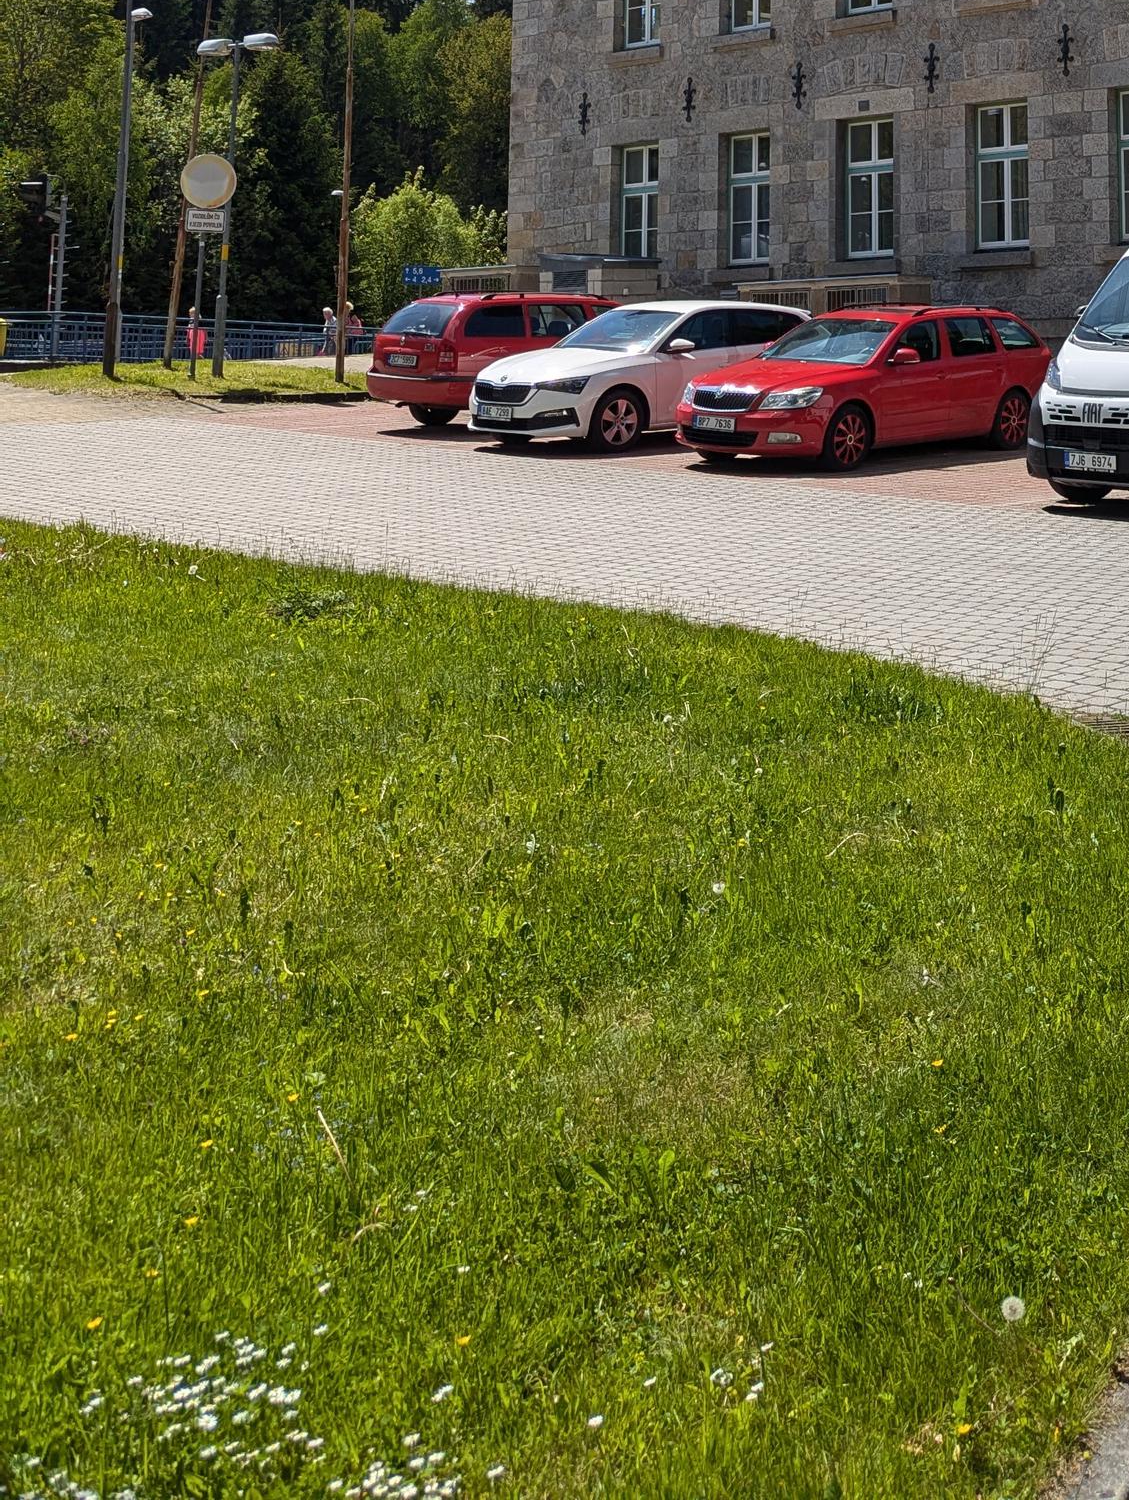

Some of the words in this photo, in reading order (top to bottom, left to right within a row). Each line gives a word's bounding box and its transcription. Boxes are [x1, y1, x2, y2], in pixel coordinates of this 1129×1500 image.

[1082, 402, 1105, 424] FIAT
[1070, 453, 1086, 466] 7J6
[1091, 455, 1112, 469] 6974
